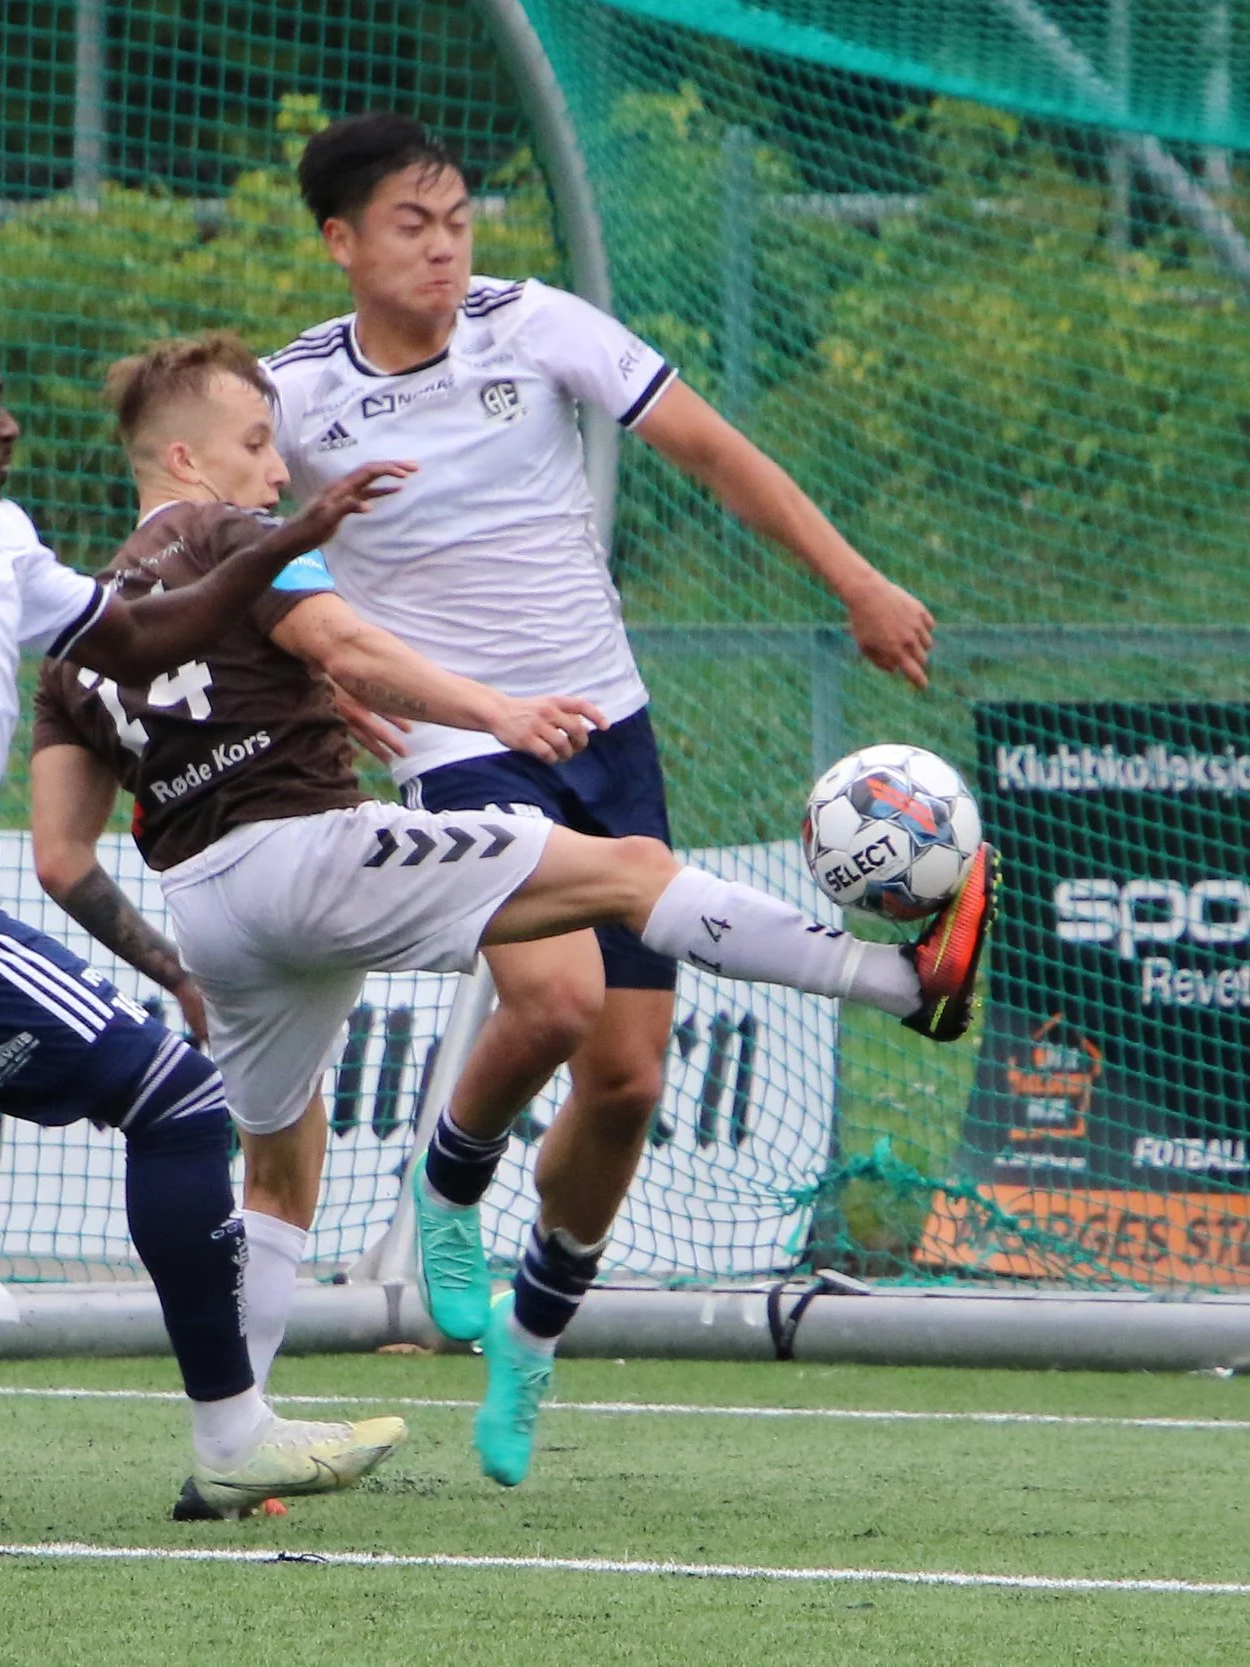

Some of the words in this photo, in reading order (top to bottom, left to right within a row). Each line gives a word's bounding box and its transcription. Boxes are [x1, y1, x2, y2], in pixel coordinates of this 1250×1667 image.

[150, 762, 213, 803] Røde
[211, 729, 272, 774] Kors
[825, 834, 897, 892] SELECT
[688, 914, 732, 973] 14
[1133, 1138, 1250, 1171] FOTBALL
